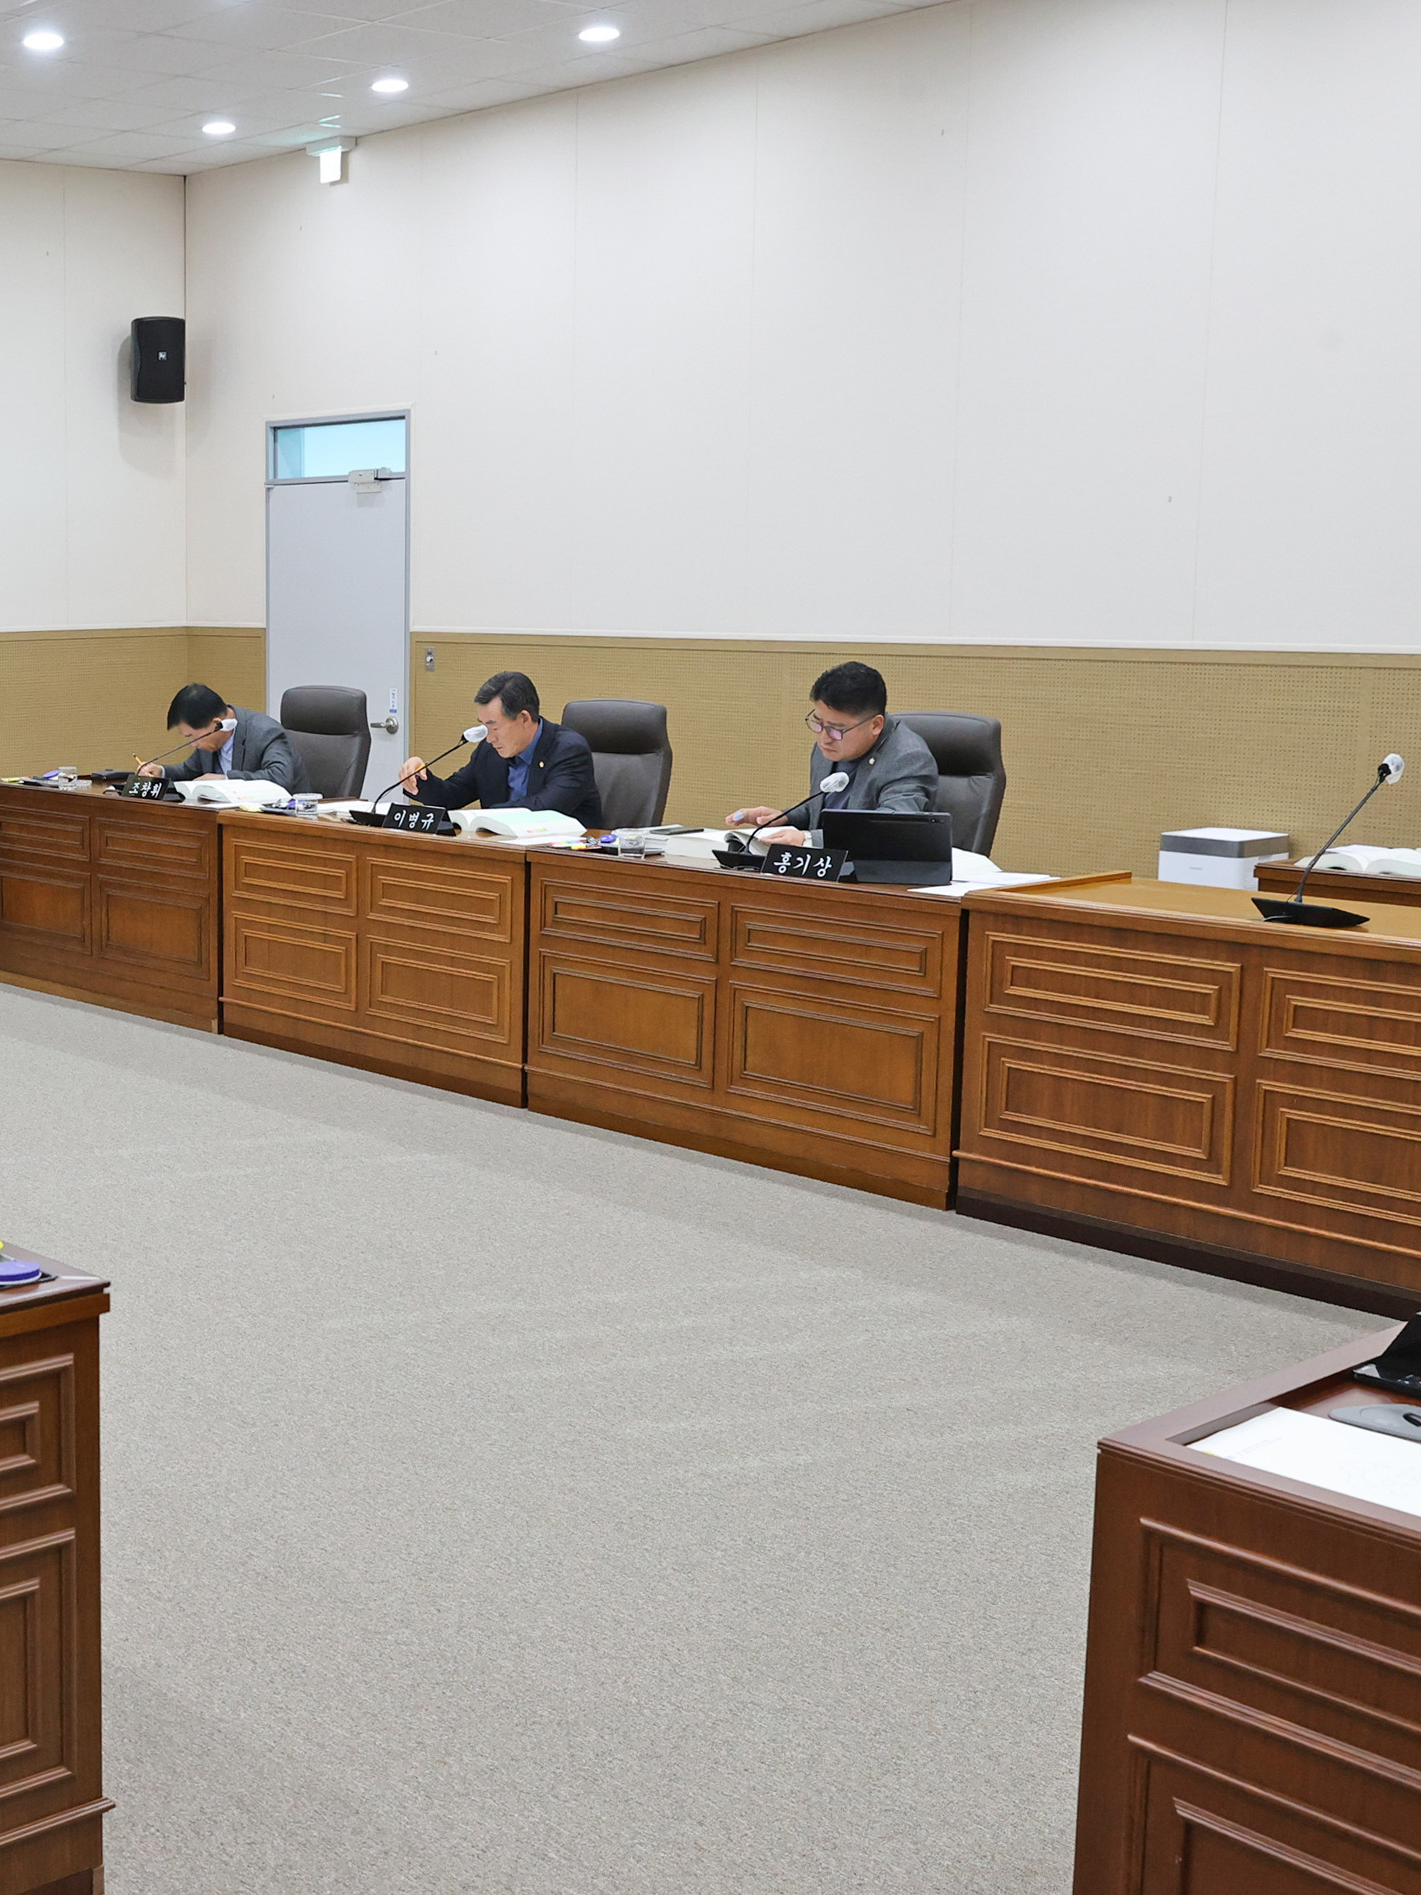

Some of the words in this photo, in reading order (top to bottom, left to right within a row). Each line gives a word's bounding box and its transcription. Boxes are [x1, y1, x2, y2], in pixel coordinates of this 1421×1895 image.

[128, 781, 163, 799] 조창휘
[394, 809, 435, 831] 이병규
[773, 851, 833, 878] 홍기상
